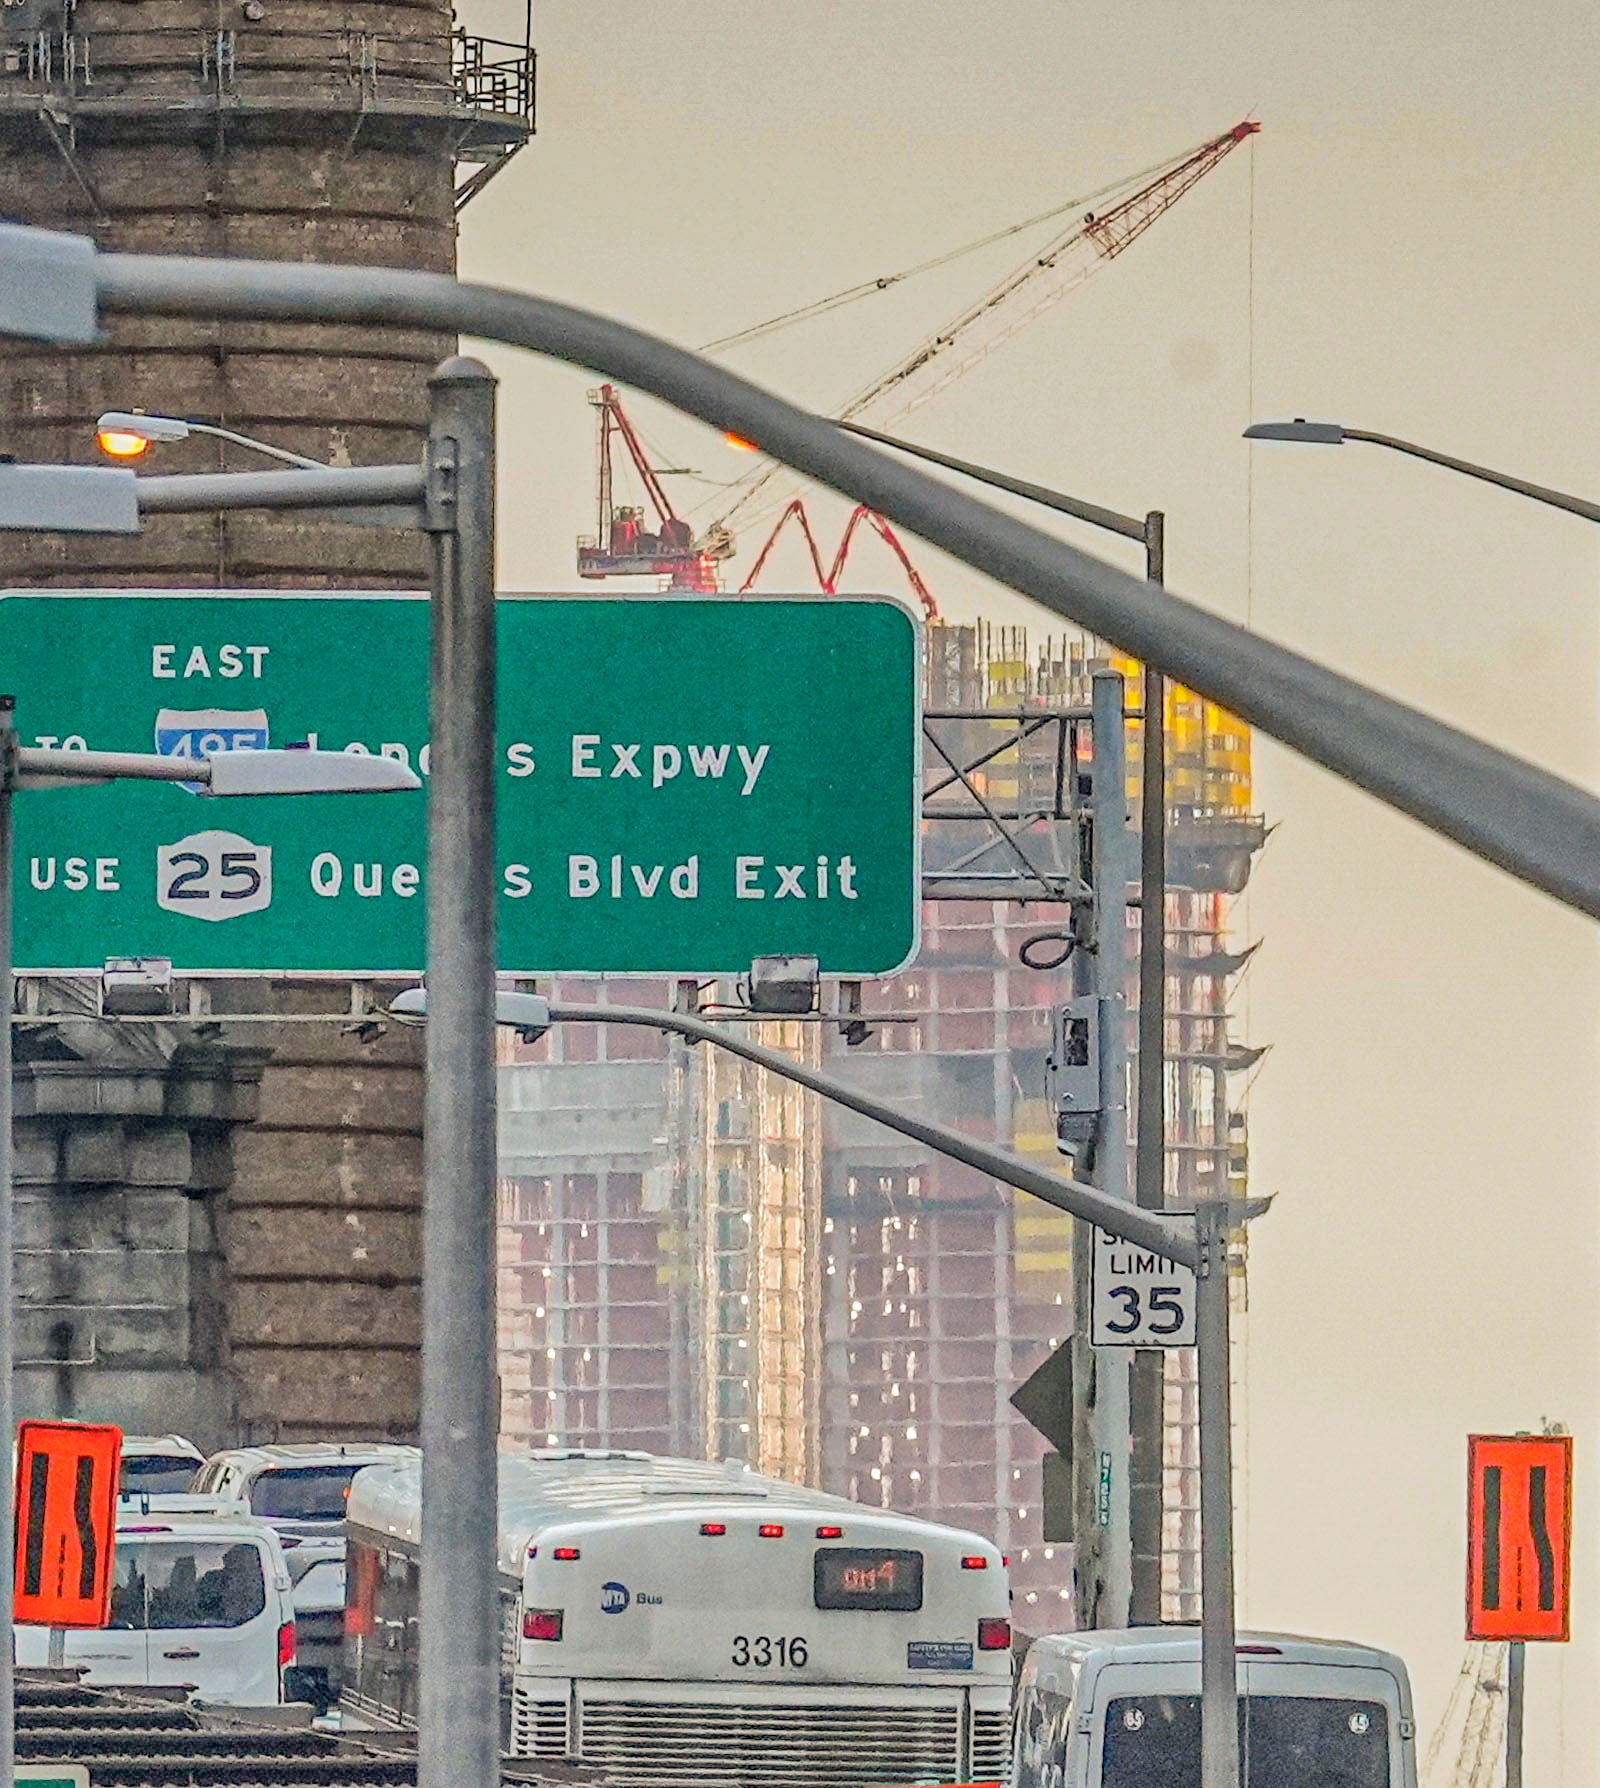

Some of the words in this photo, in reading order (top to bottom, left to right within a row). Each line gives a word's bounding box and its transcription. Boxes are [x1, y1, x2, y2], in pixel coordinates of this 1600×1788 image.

[152, 645, 270, 679] EAST
[571, 734, 770, 796] Expwy
[30, 857, 121, 891] USE
[168, 853, 261, 899] 25
[310, 852, 533, 898] Ques
[568, 854, 699, 898] Blvd
[736, 854, 859, 899] Exit
[1105, 1286, 1185, 1335] 35
[636, 1592, 663, 1605] Bus
[731, 1636, 808, 1667] 3316
